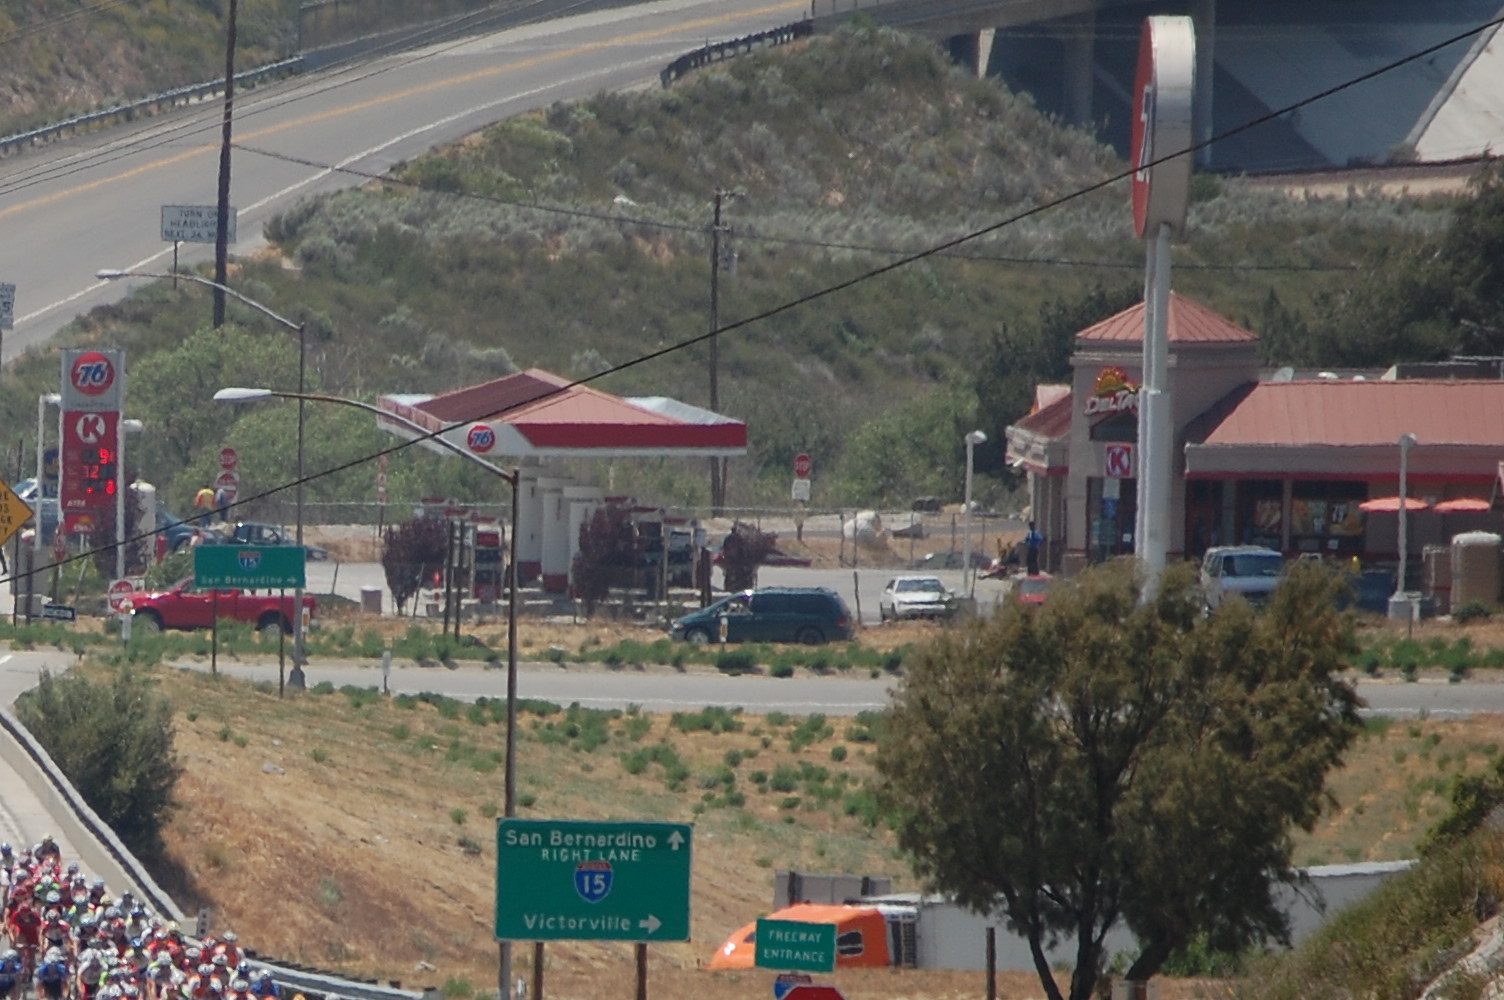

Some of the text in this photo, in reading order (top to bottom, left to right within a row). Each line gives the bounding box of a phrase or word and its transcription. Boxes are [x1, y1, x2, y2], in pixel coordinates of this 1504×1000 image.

[77, 361, 107, 387] 76
[82, 416, 100, 438] K
[470, 429, 491, 448] 76
[244, 558, 256, 568] 15
[201, 576, 283, 585] San Bernardino
[505, 829, 657, 848] San Bernardino
[542, 848, 640, 862] RIGHT LANE
[583, 873, 606, 895] 15
[524, 912, 632, 931] Victorville
[769, 929, 822, 943] FREEWAY
[764, 948, 826, 963] ENTRANCE
